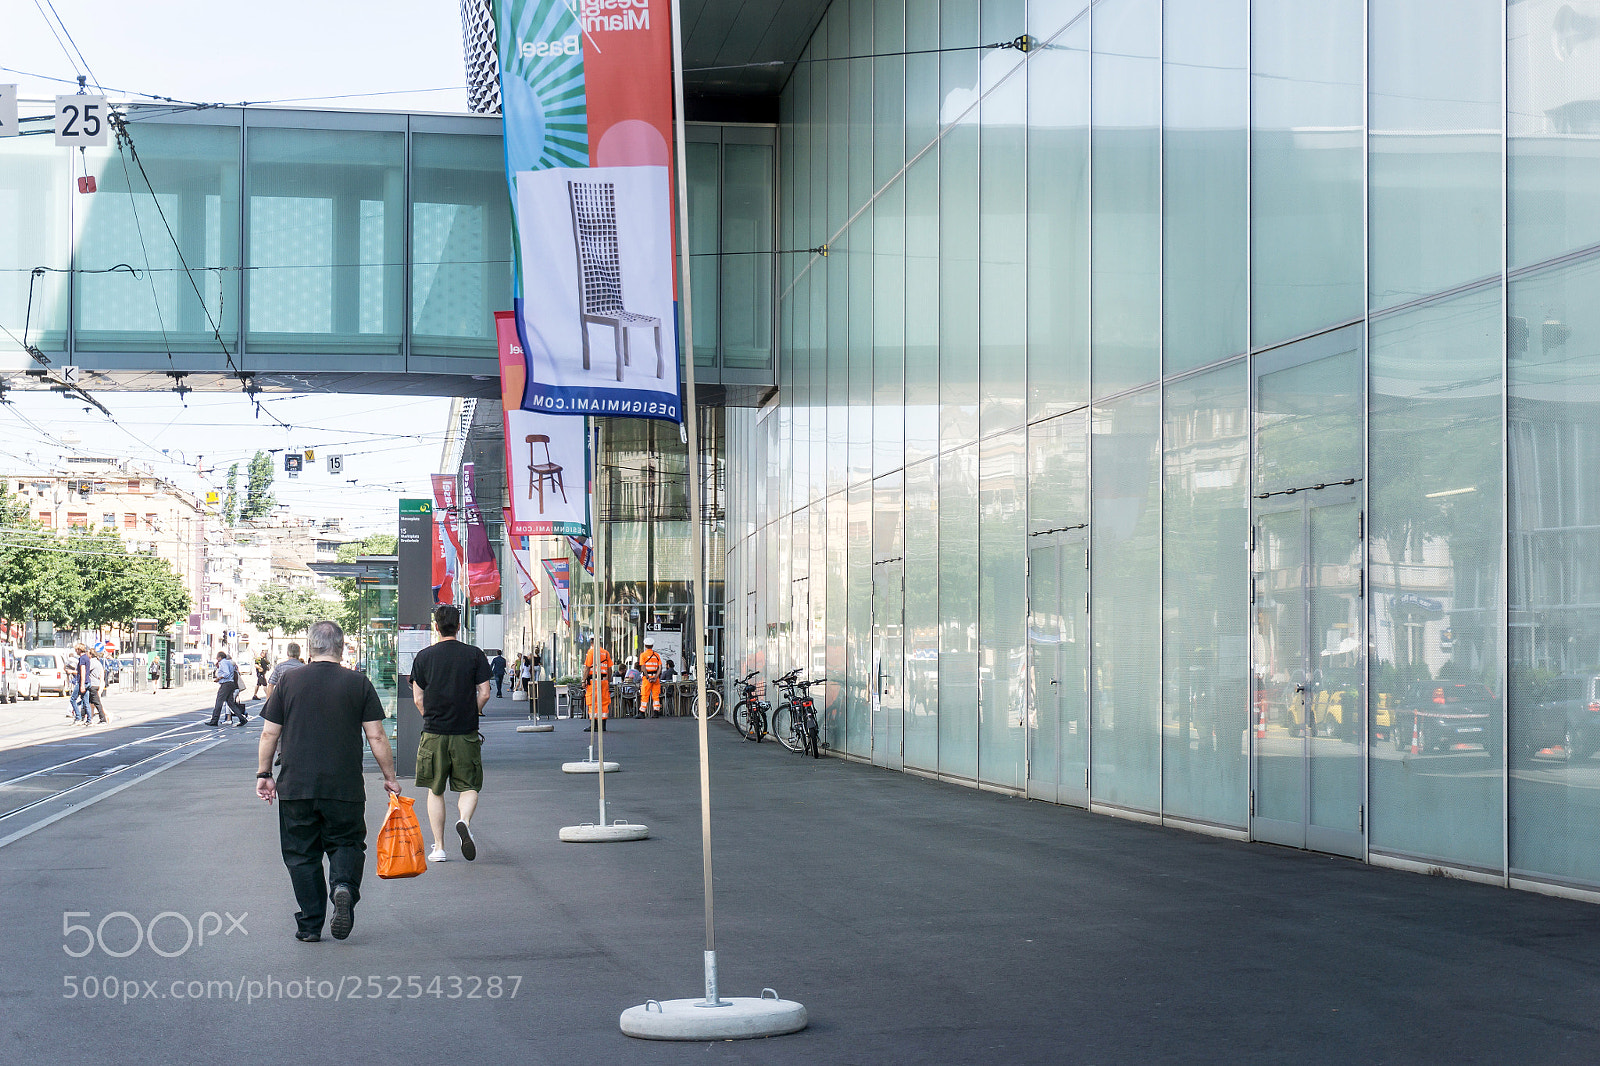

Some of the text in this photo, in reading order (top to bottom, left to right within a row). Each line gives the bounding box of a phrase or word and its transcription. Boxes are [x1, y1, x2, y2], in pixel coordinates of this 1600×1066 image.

[62, 105, 101, 136] 25
[65, 368, 75, 381] K
[329, 457, 341, 469] 15
